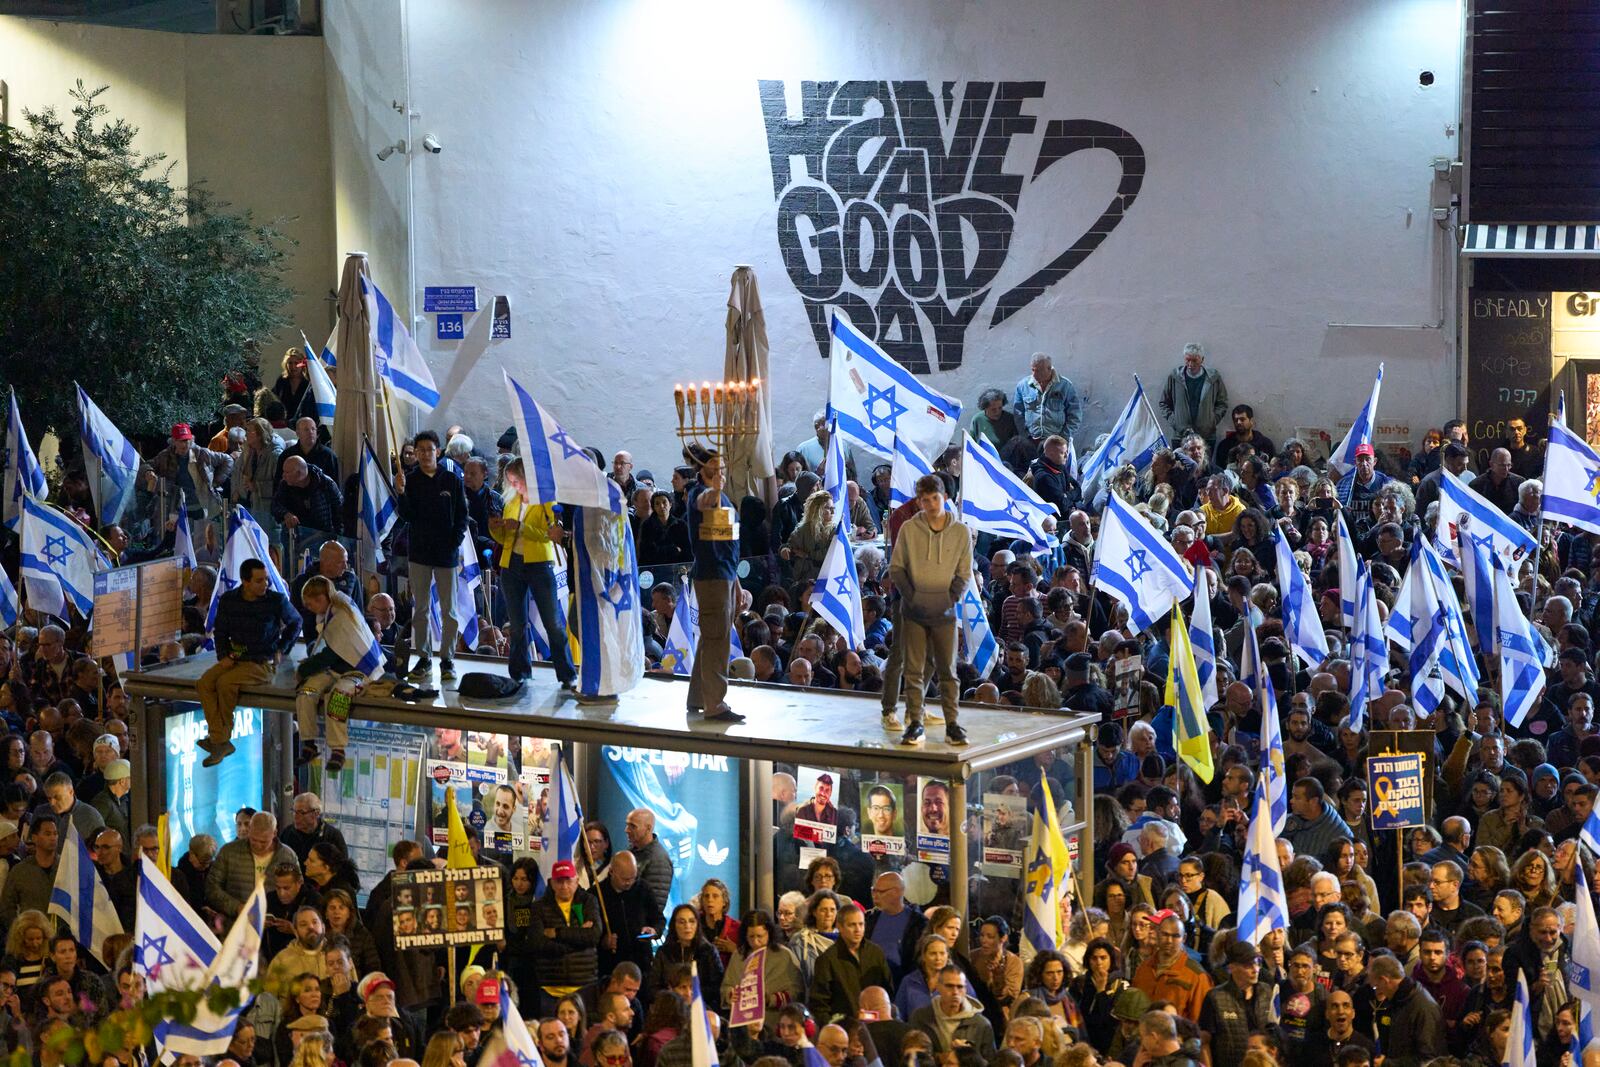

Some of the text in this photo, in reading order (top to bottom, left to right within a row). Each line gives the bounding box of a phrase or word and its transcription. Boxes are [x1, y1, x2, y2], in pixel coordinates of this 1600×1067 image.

[777, 186, 1015, 302] GOOD
[1474, 298, 1548, 318] BREADLY
[440, 321, 462, 333] 136
[801, 278, 993, 374] DAY
[1499, 387, 1537, 407] קפה
[1376, 424, 1409, 434] סליחה
[1474, 419, 1538, 440] Cofe
[170, 708, 254, 755] SUPEAR
[1373, 762, 1394, 773] הרוב
[1396, 776, 1420, 788] בעד
[1388, 786, 1420, 800] עסקת
[1378, 797, 1421, 811] חטופים
[825, 830, 835, 838] עד
[513, 838, 523, 846] עד
[893, 842, 903, 850] עד
[415, 871, 443, 884] כולם
[445, 868, 471, 881] כולל
[472, 866, 499, 879] כולם
[396, 929, 504, 950] עד החטוף האחרון!
